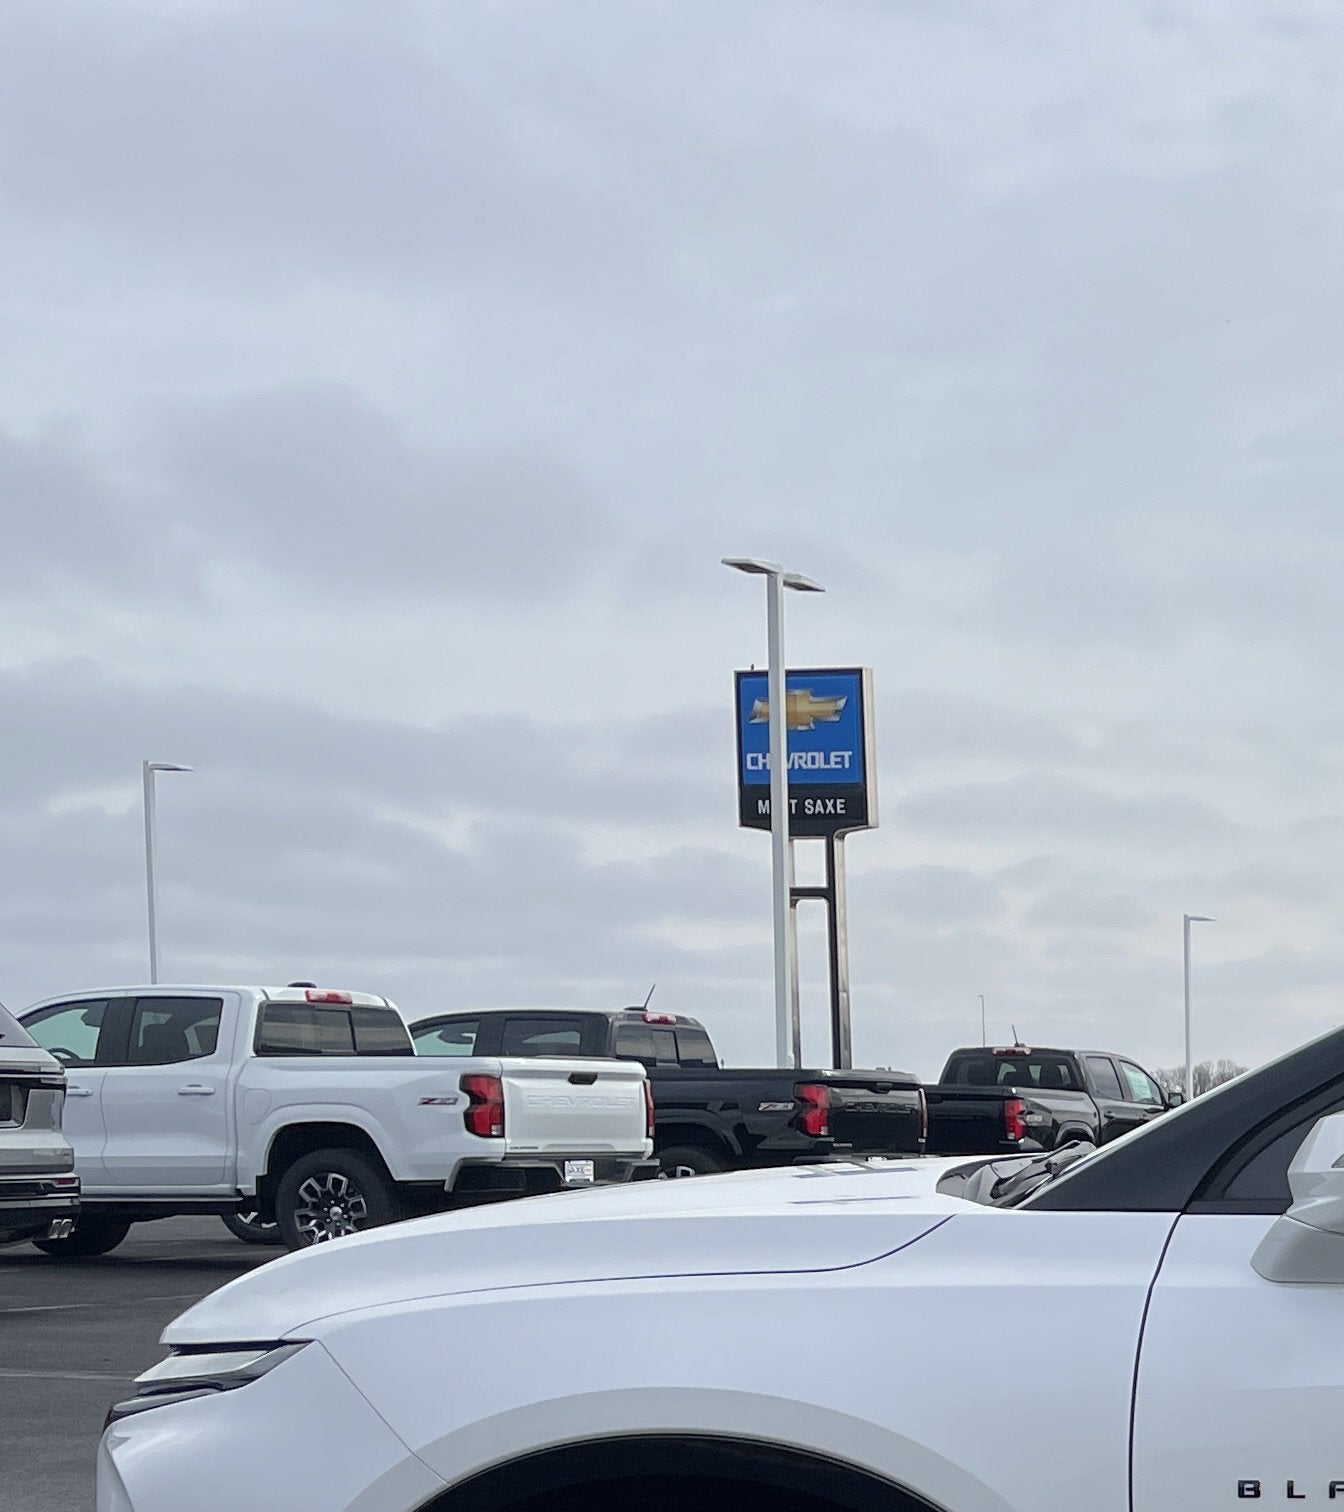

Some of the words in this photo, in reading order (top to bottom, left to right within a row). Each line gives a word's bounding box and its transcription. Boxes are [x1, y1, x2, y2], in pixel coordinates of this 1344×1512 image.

[747, 751, 853, 770] CHVROLET
[758, 799, 798, 815] MT
[804, 798, 846, 815] SAXE
